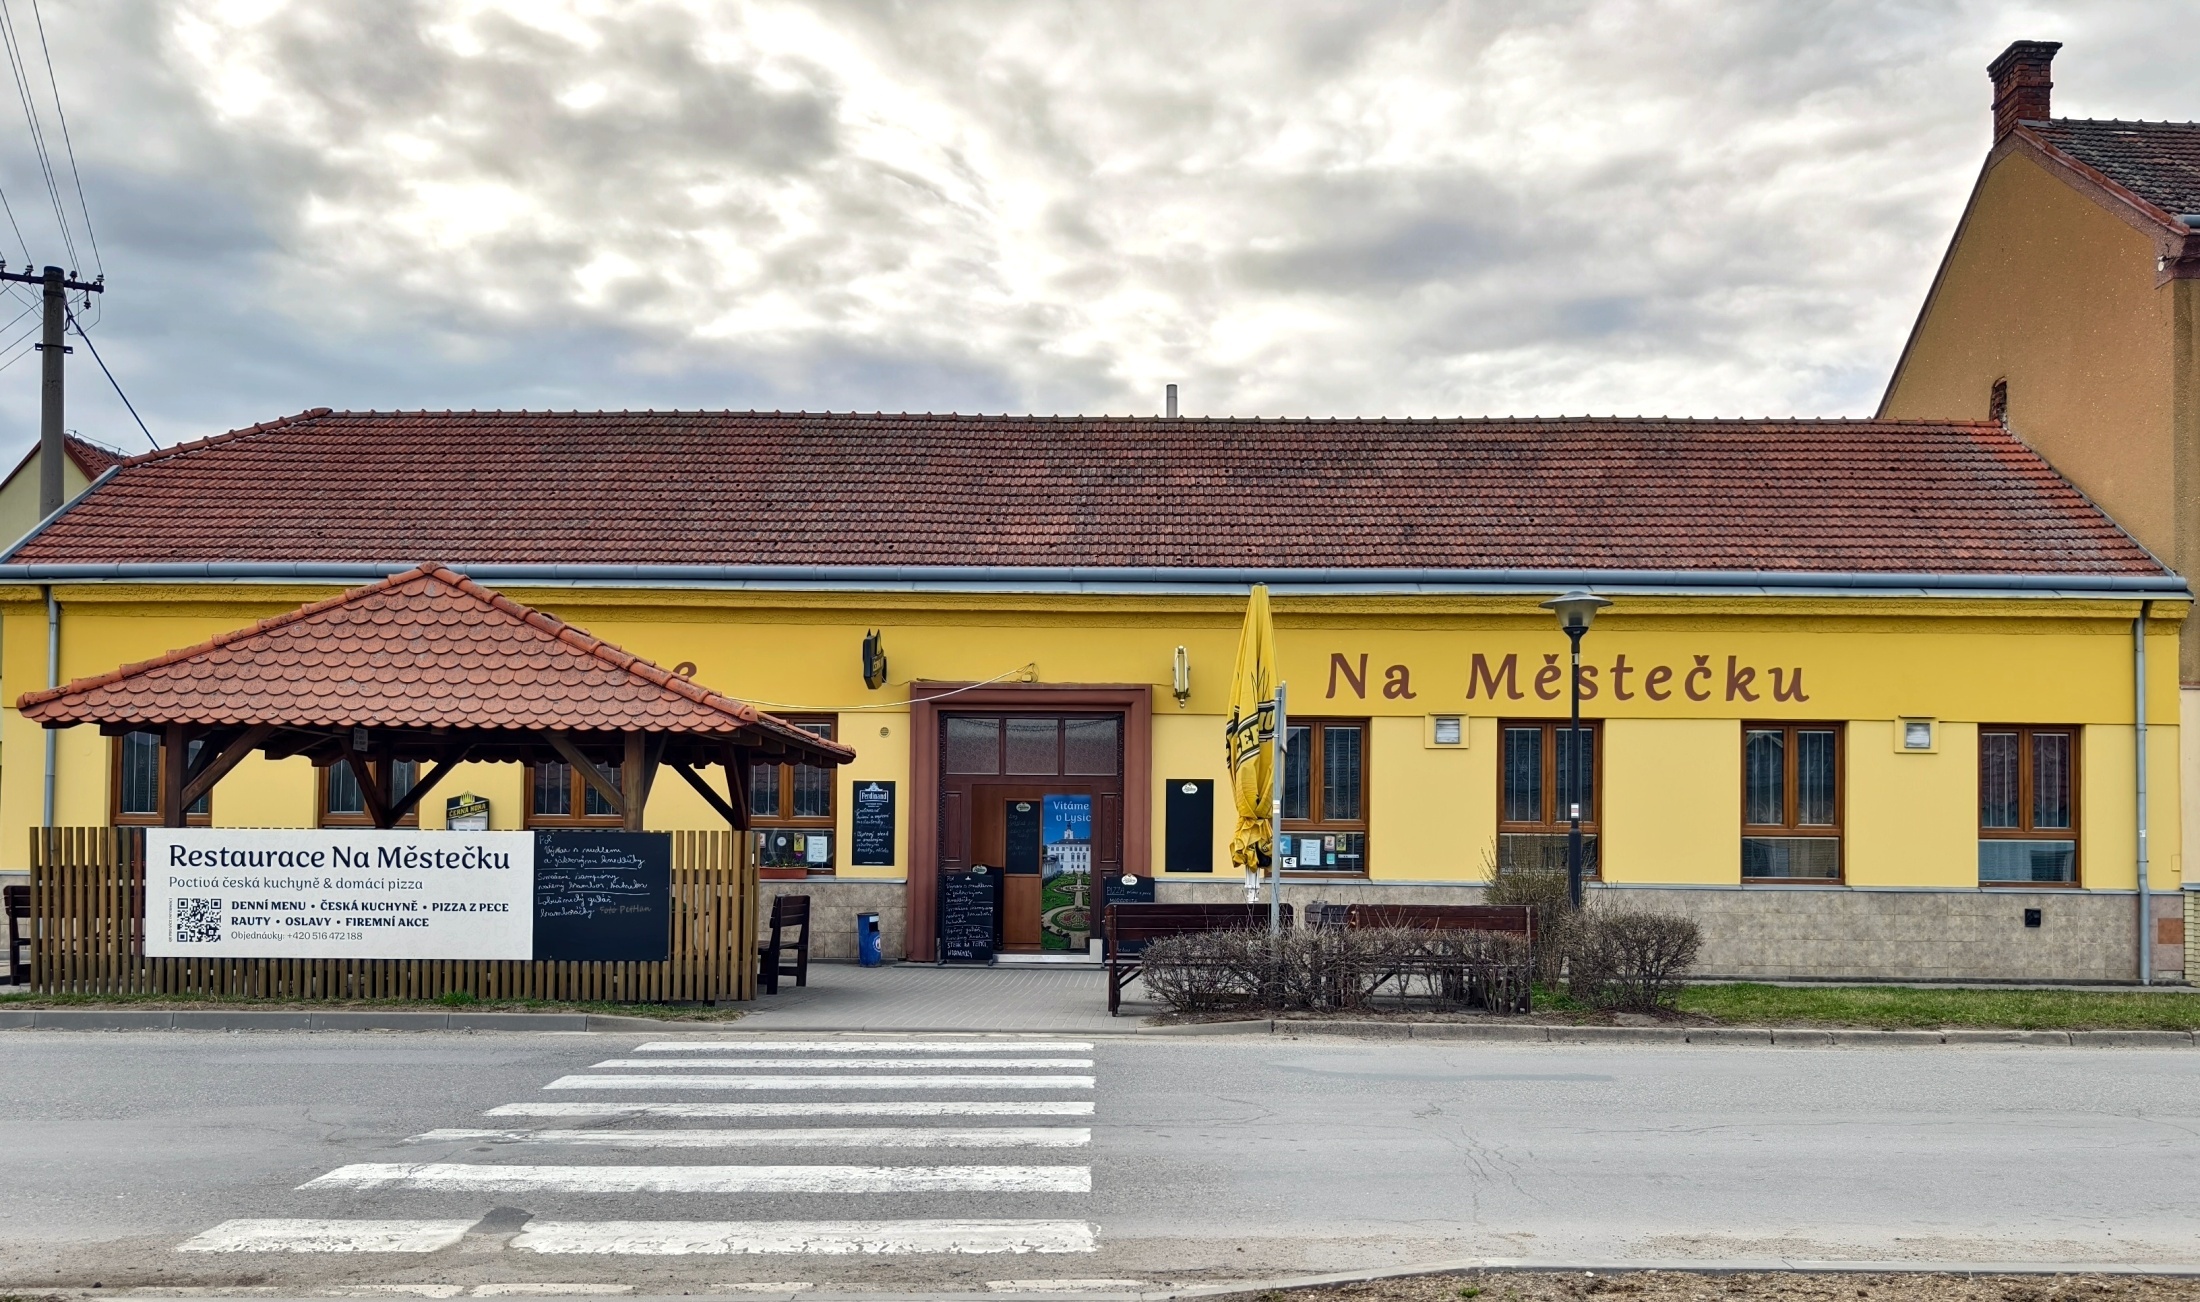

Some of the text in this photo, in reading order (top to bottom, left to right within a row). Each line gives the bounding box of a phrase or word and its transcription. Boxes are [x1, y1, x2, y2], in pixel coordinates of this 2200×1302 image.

[1325, 652, 1810, 703] Na Městečku
[861, 792, 887, 800] Ferdinand
[1053, 801, 1090, 811] Vitáme
[169, 845, 511, 869] Restaurace Na Městečku
[169, 876, 423, 891] Poctivá česká kuchyně & domácí pizza
[231, 899, 306, 911] DENNÍ MENU
[320, 899, 418, 912] ČESKÁ KUCHYNĚ
[432, 902, 509, 912] PIZZA Z PECE
[231, 916, 271, 926] RAUTY
[285, 916, 332, 926] OSLAVY
[345, 915, 429, 927] FIREMNÍ AKCE
[231, 931, 363, 941] Objednávky: +420 516 472 188
